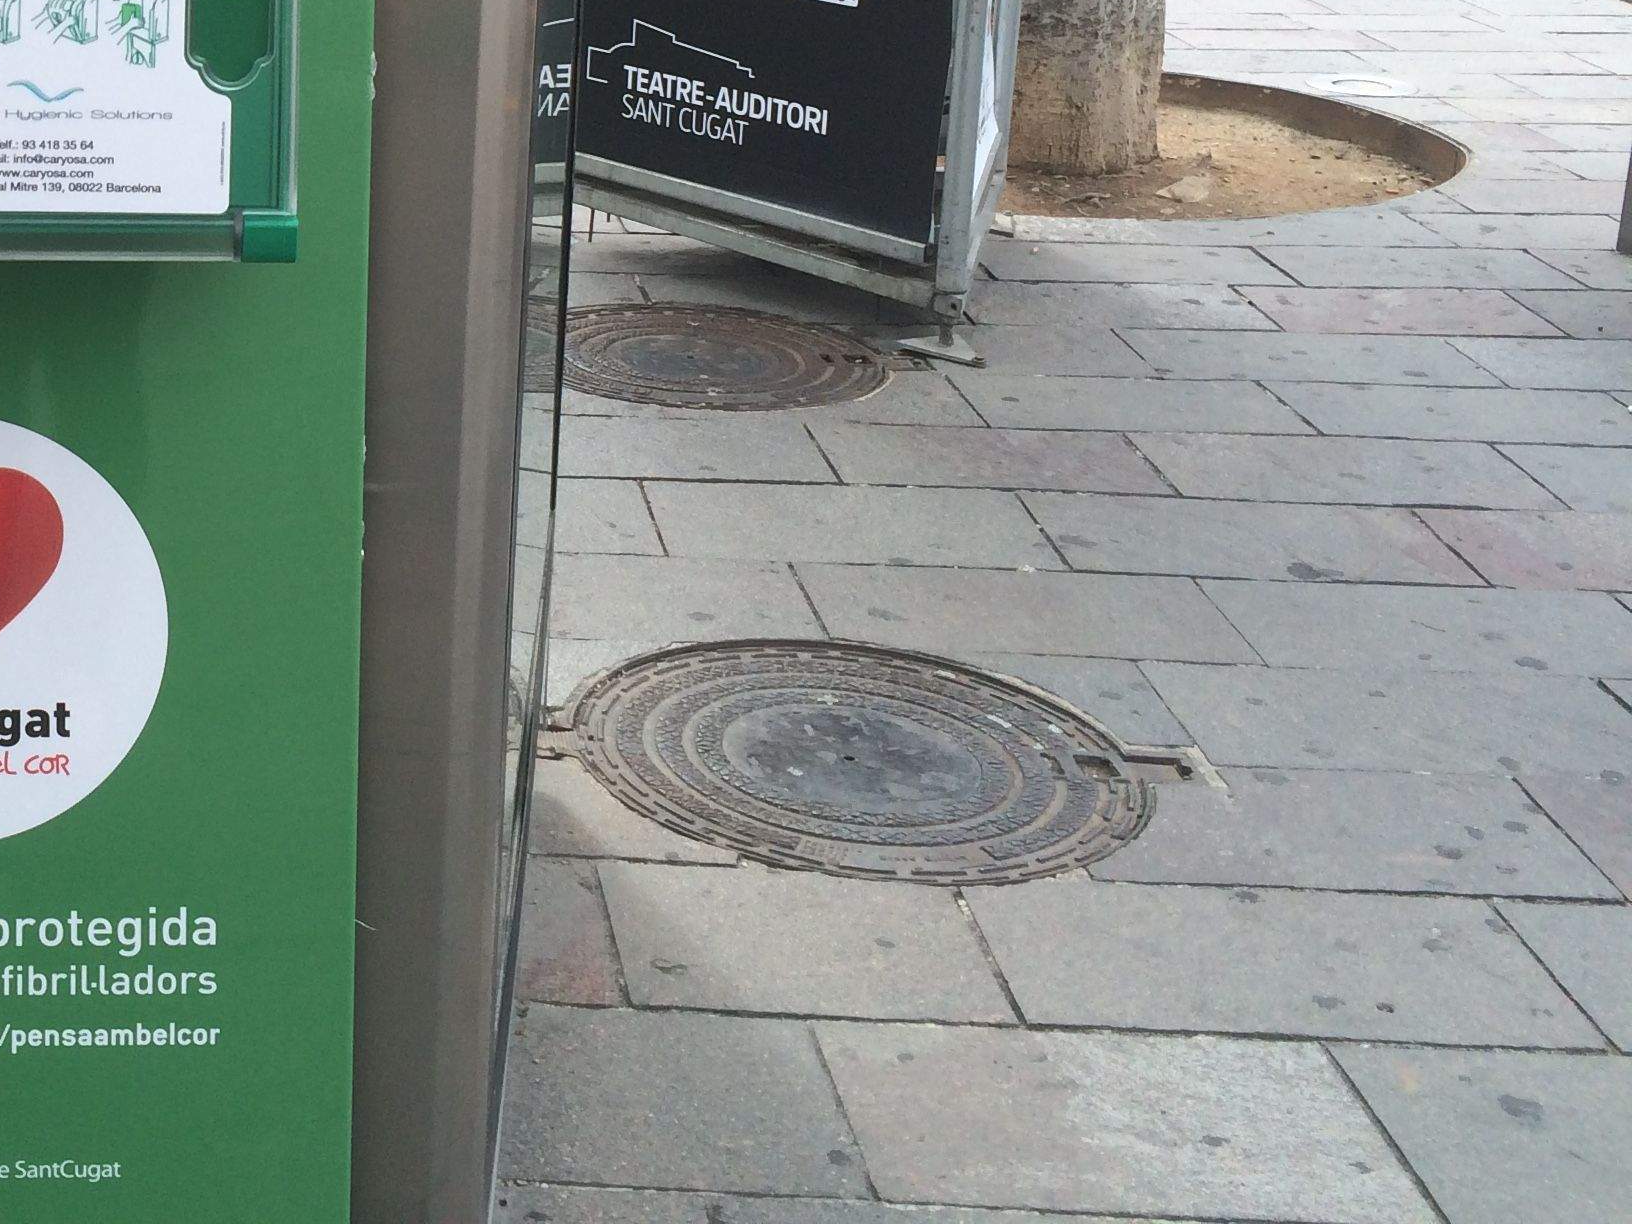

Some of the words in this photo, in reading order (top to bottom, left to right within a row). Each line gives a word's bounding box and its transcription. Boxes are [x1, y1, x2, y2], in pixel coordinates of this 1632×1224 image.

[623, 64, 828, 136] TEATRE-AUDITORI
[5, 108, 84, 121] Hygienic
[90, 109, 173, 120] Solutions
[621, 93, 675, 128] SANT
[678, 106, 750, 146] CUGAT
[21, 140, 36, 150] 93
[39, 140, 60, 150] 418
[63, 140, 78, 150] 35
[80, 140, 94, 150] 64
[13, 154, 115, 167] info@caryosa.com
[10, 181, 38, 192] Mitre
[42, 182, 66, 193] 139,
[68, 182, 103, 193] 08022
[106, 182, 161, 194] Barcelona
[14, 1159, 122, 1183] SantCugat
